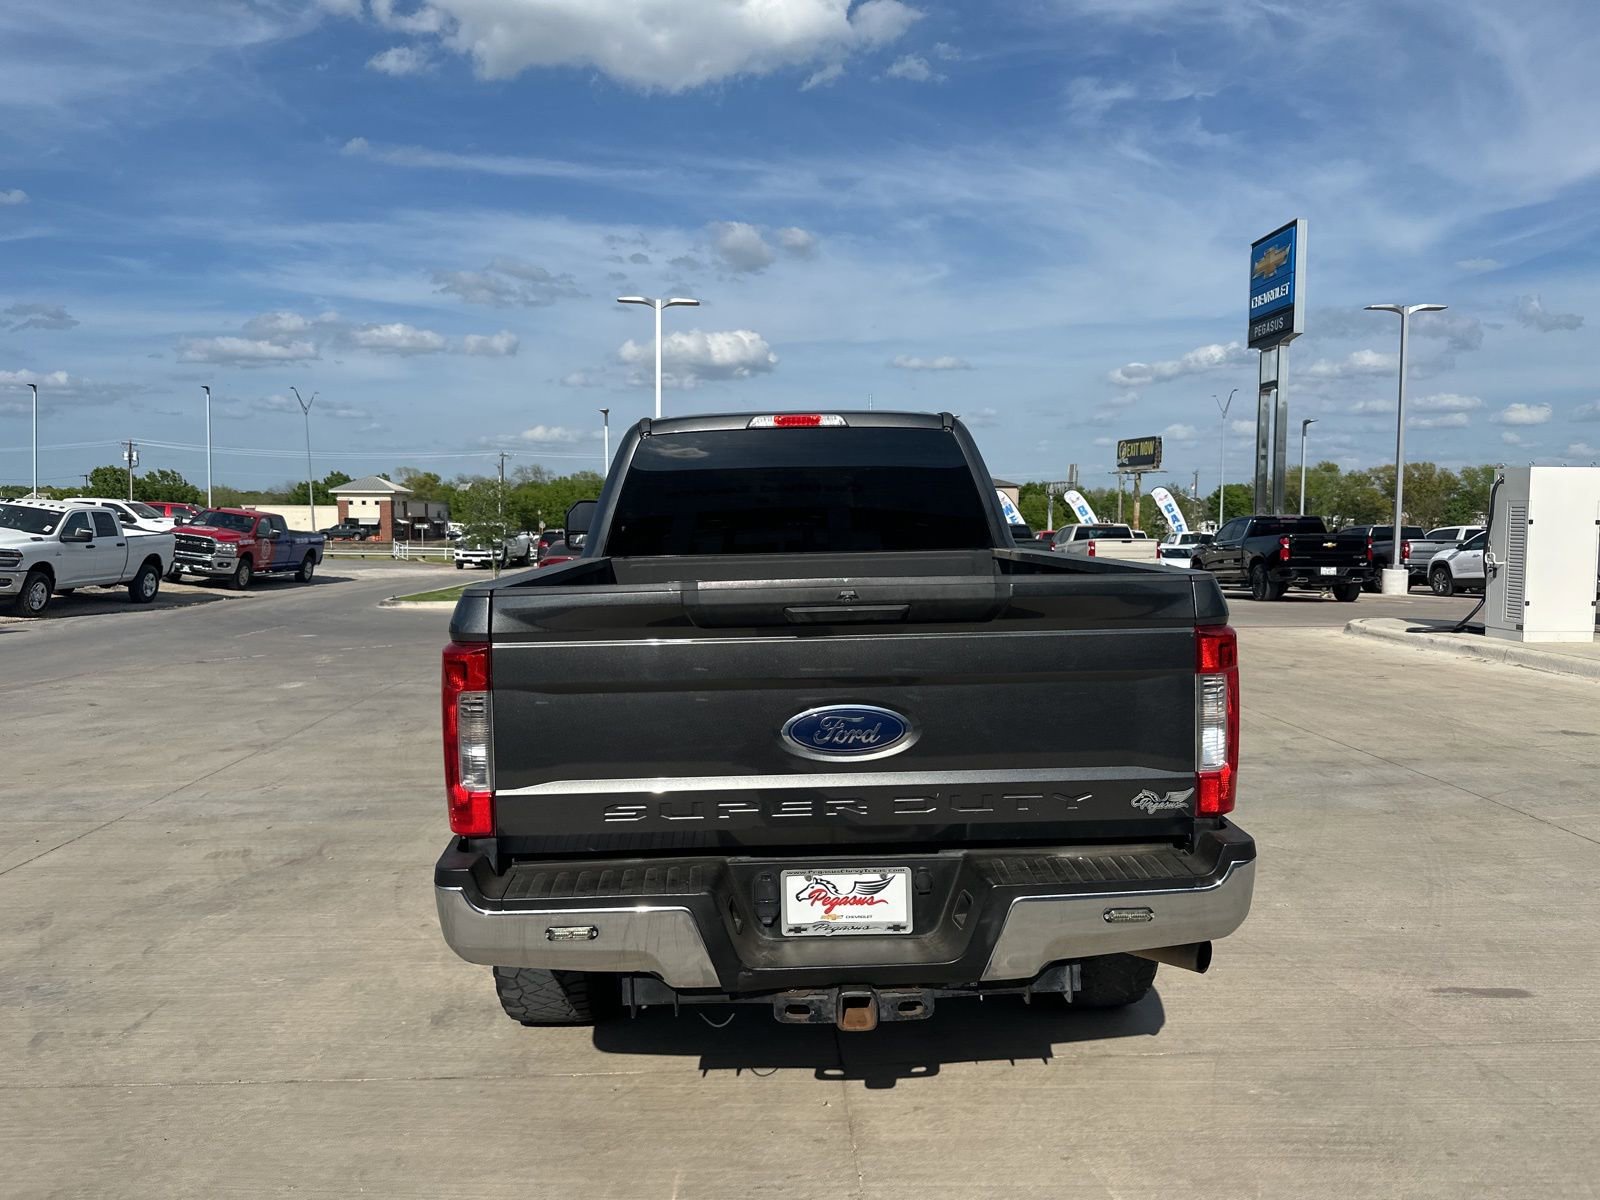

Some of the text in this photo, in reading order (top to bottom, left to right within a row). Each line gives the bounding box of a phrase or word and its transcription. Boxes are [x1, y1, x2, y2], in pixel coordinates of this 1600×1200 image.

[1251, 282, 1290, 309] CHEVROLET
[1254, 317, 1284, 338] PEGASUS
[1126, 440, 1155, 457] EXIT NOW
[813, 716, 882, 745] Ford
[603, 792, 1094, 822] SUPER DUTY
[1139, 798, 1189, 815] Pegasus
[808, 888, 889, 914] Pegasus
[813, 922, 883, 935] Pegasus
